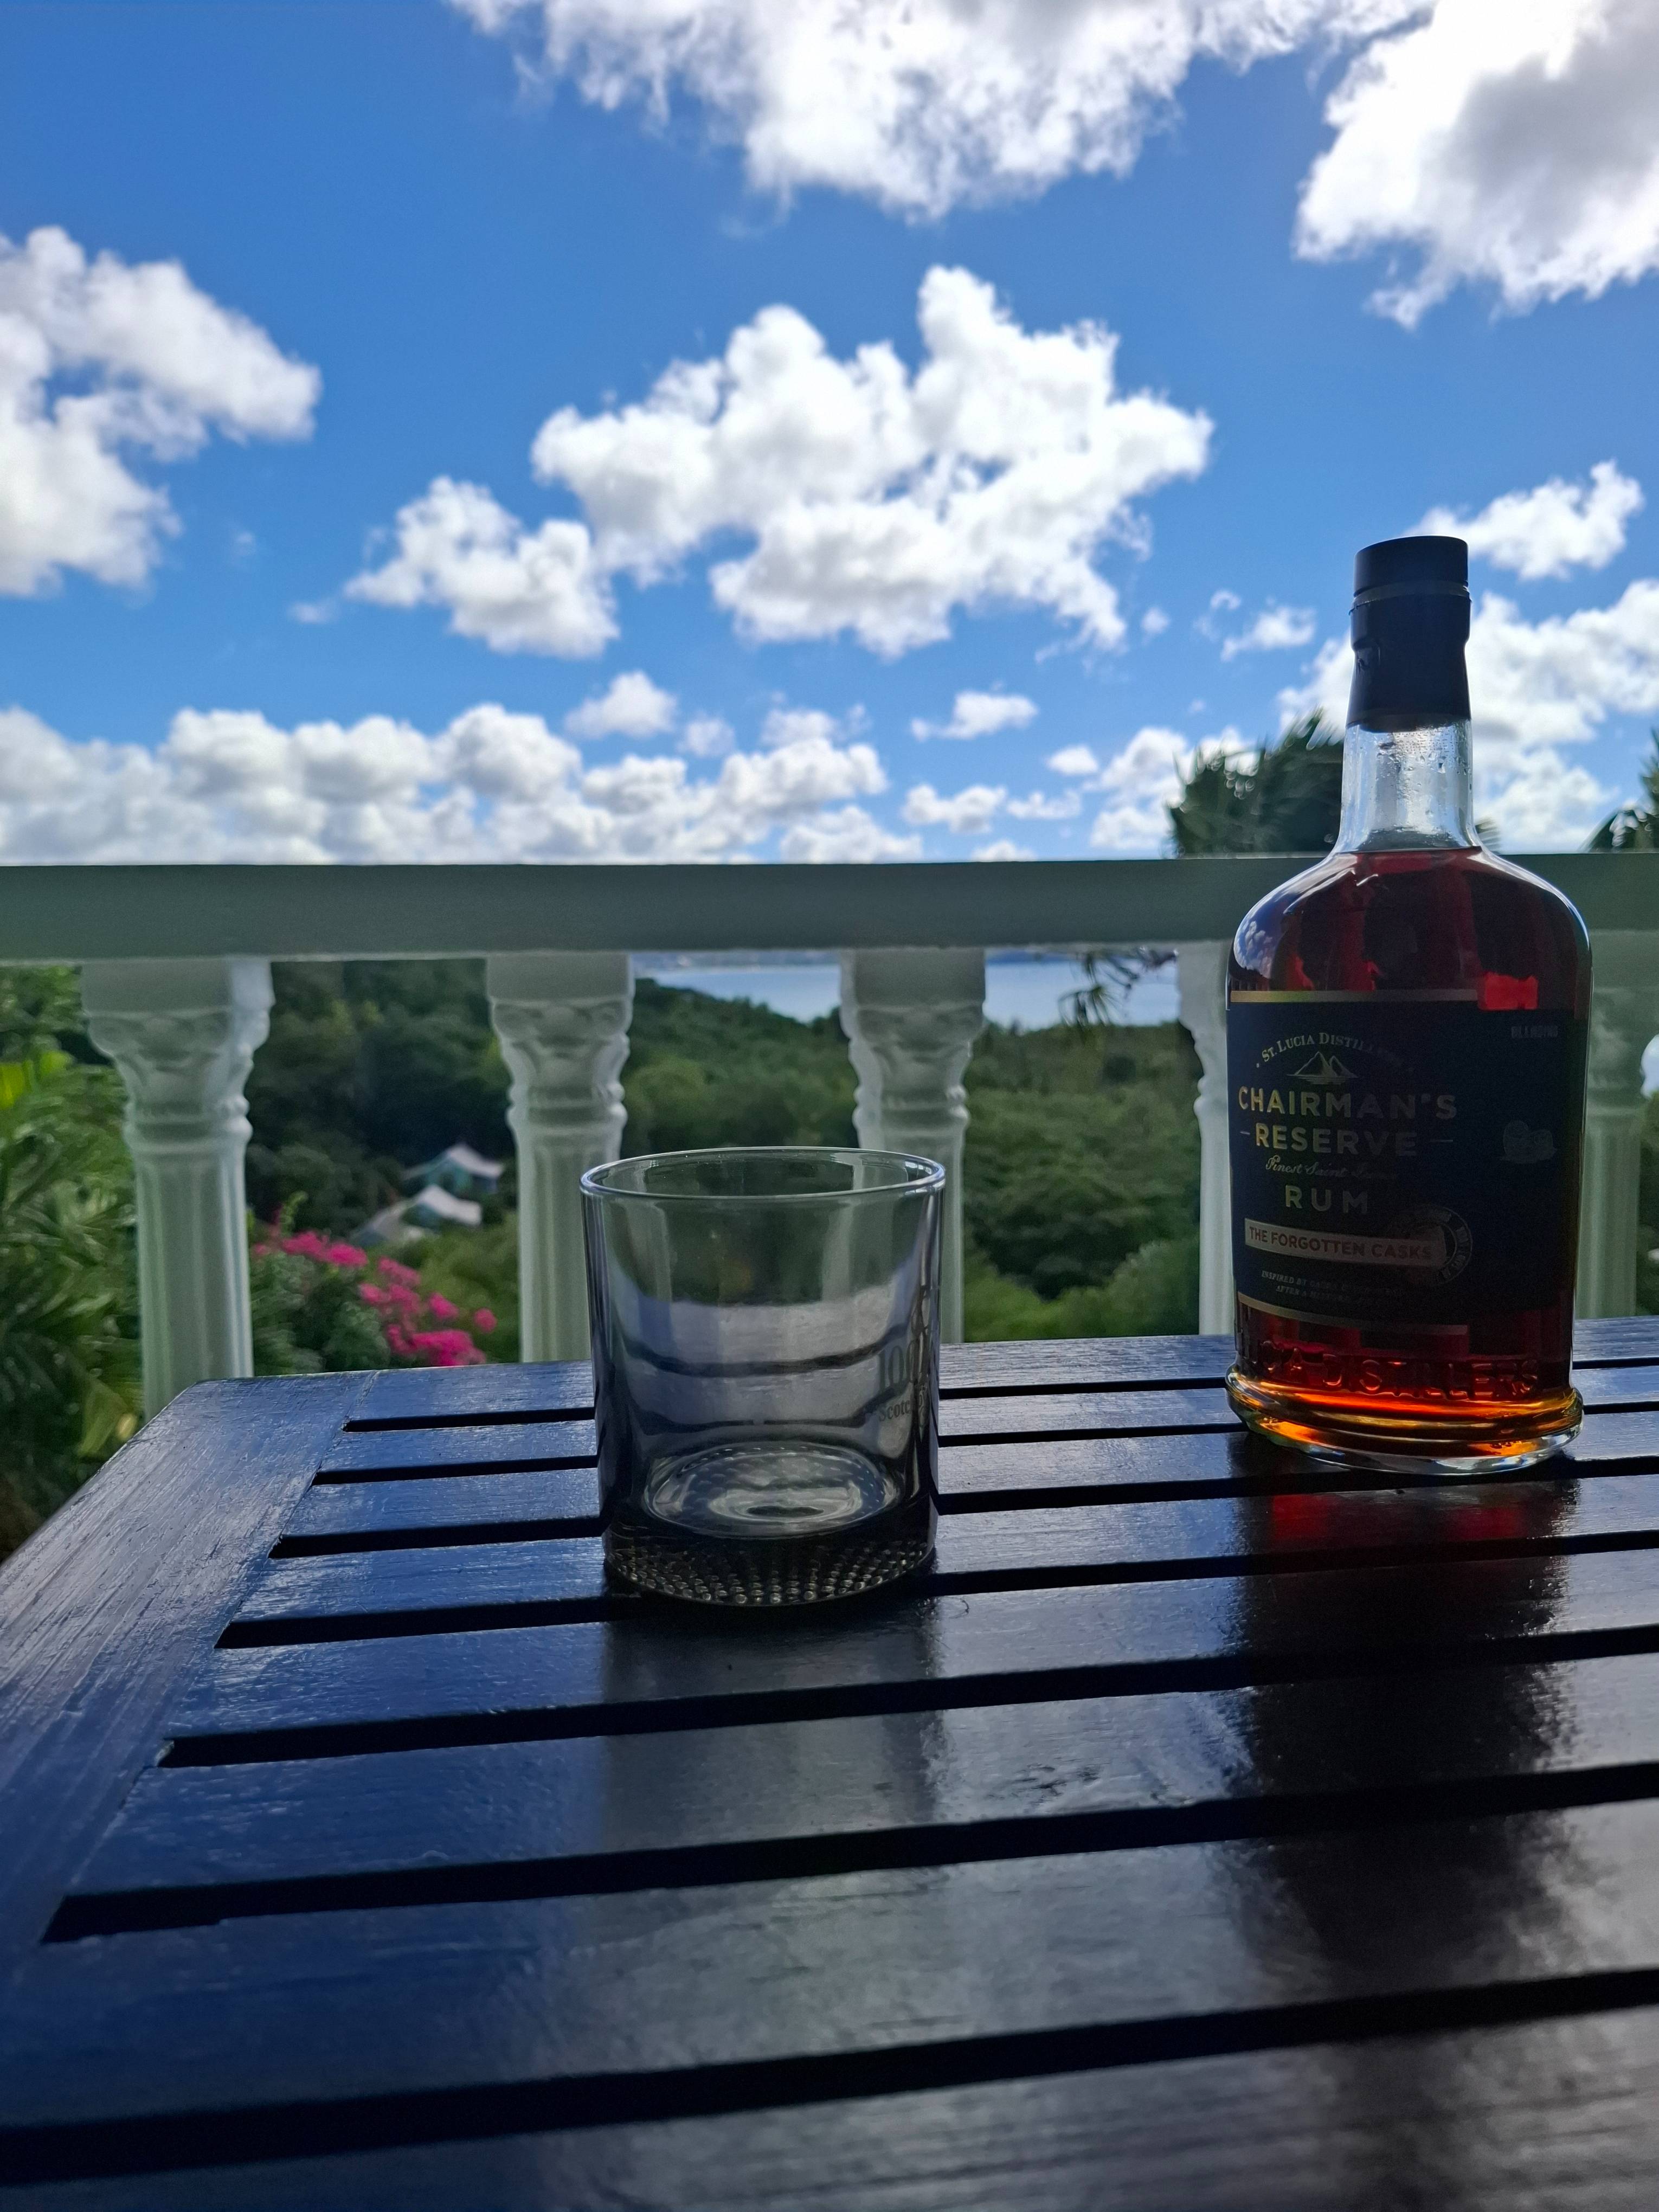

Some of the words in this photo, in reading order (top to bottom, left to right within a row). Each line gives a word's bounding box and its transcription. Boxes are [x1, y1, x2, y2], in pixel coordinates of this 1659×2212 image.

[1277, 1034, 1315, 1052] LUCIA
[1238, 1085, 1457, 1120] CHAIRMAN'S
[1255, 1122, 1417, 1156] RESERVE
[1285, 1184, 1368, 1214] RUM
[1249, 1226, 1268, 1243] THE
[1271, 1231, 1365, 1257] FORGOTTEN
[1371, 1244, 1432, 1259] CASKS
